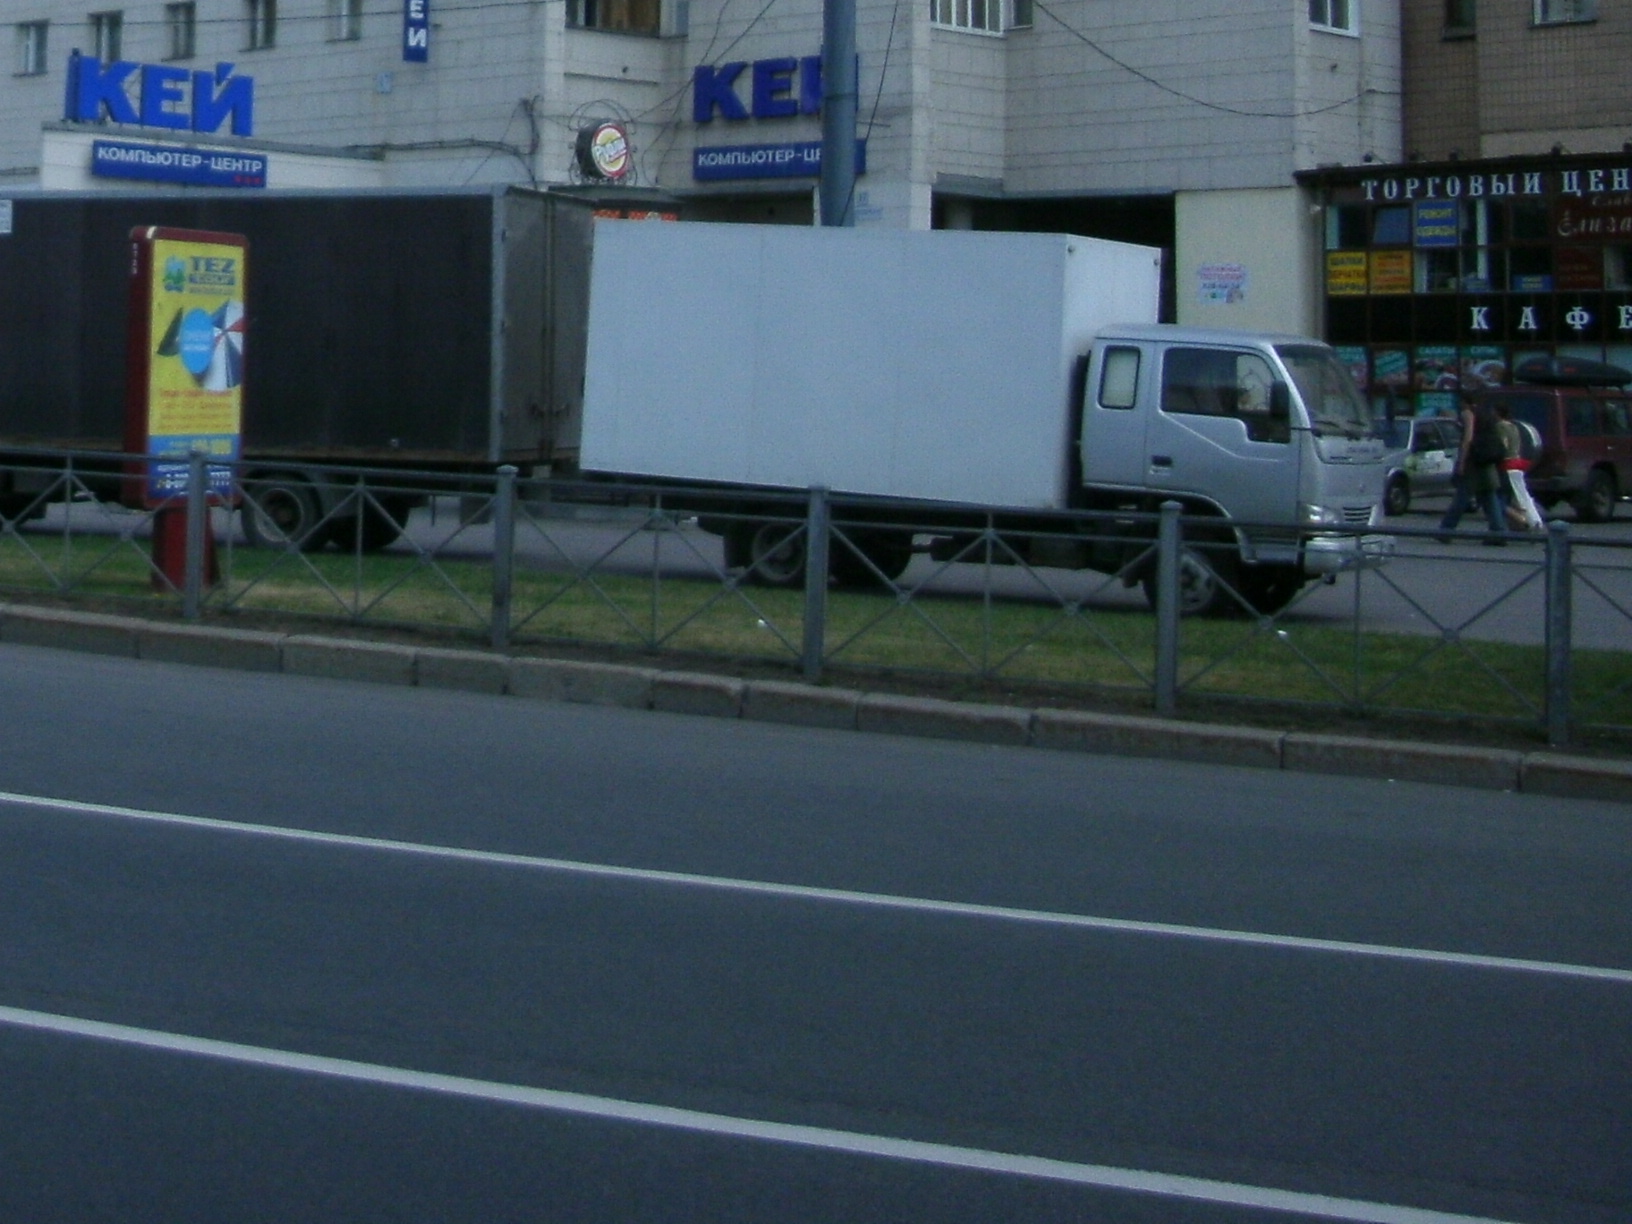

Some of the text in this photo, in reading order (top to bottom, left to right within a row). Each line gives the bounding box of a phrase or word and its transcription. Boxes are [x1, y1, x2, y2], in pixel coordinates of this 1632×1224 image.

[66, 54, 255, 137] КЕЙ
[98, 146, 263, 173] КОМПЬЮТЕР-ЦЕНТР
[190, 256, 236, 274] TEZ
[1470, 305, 1632, 330] КАФЕ
